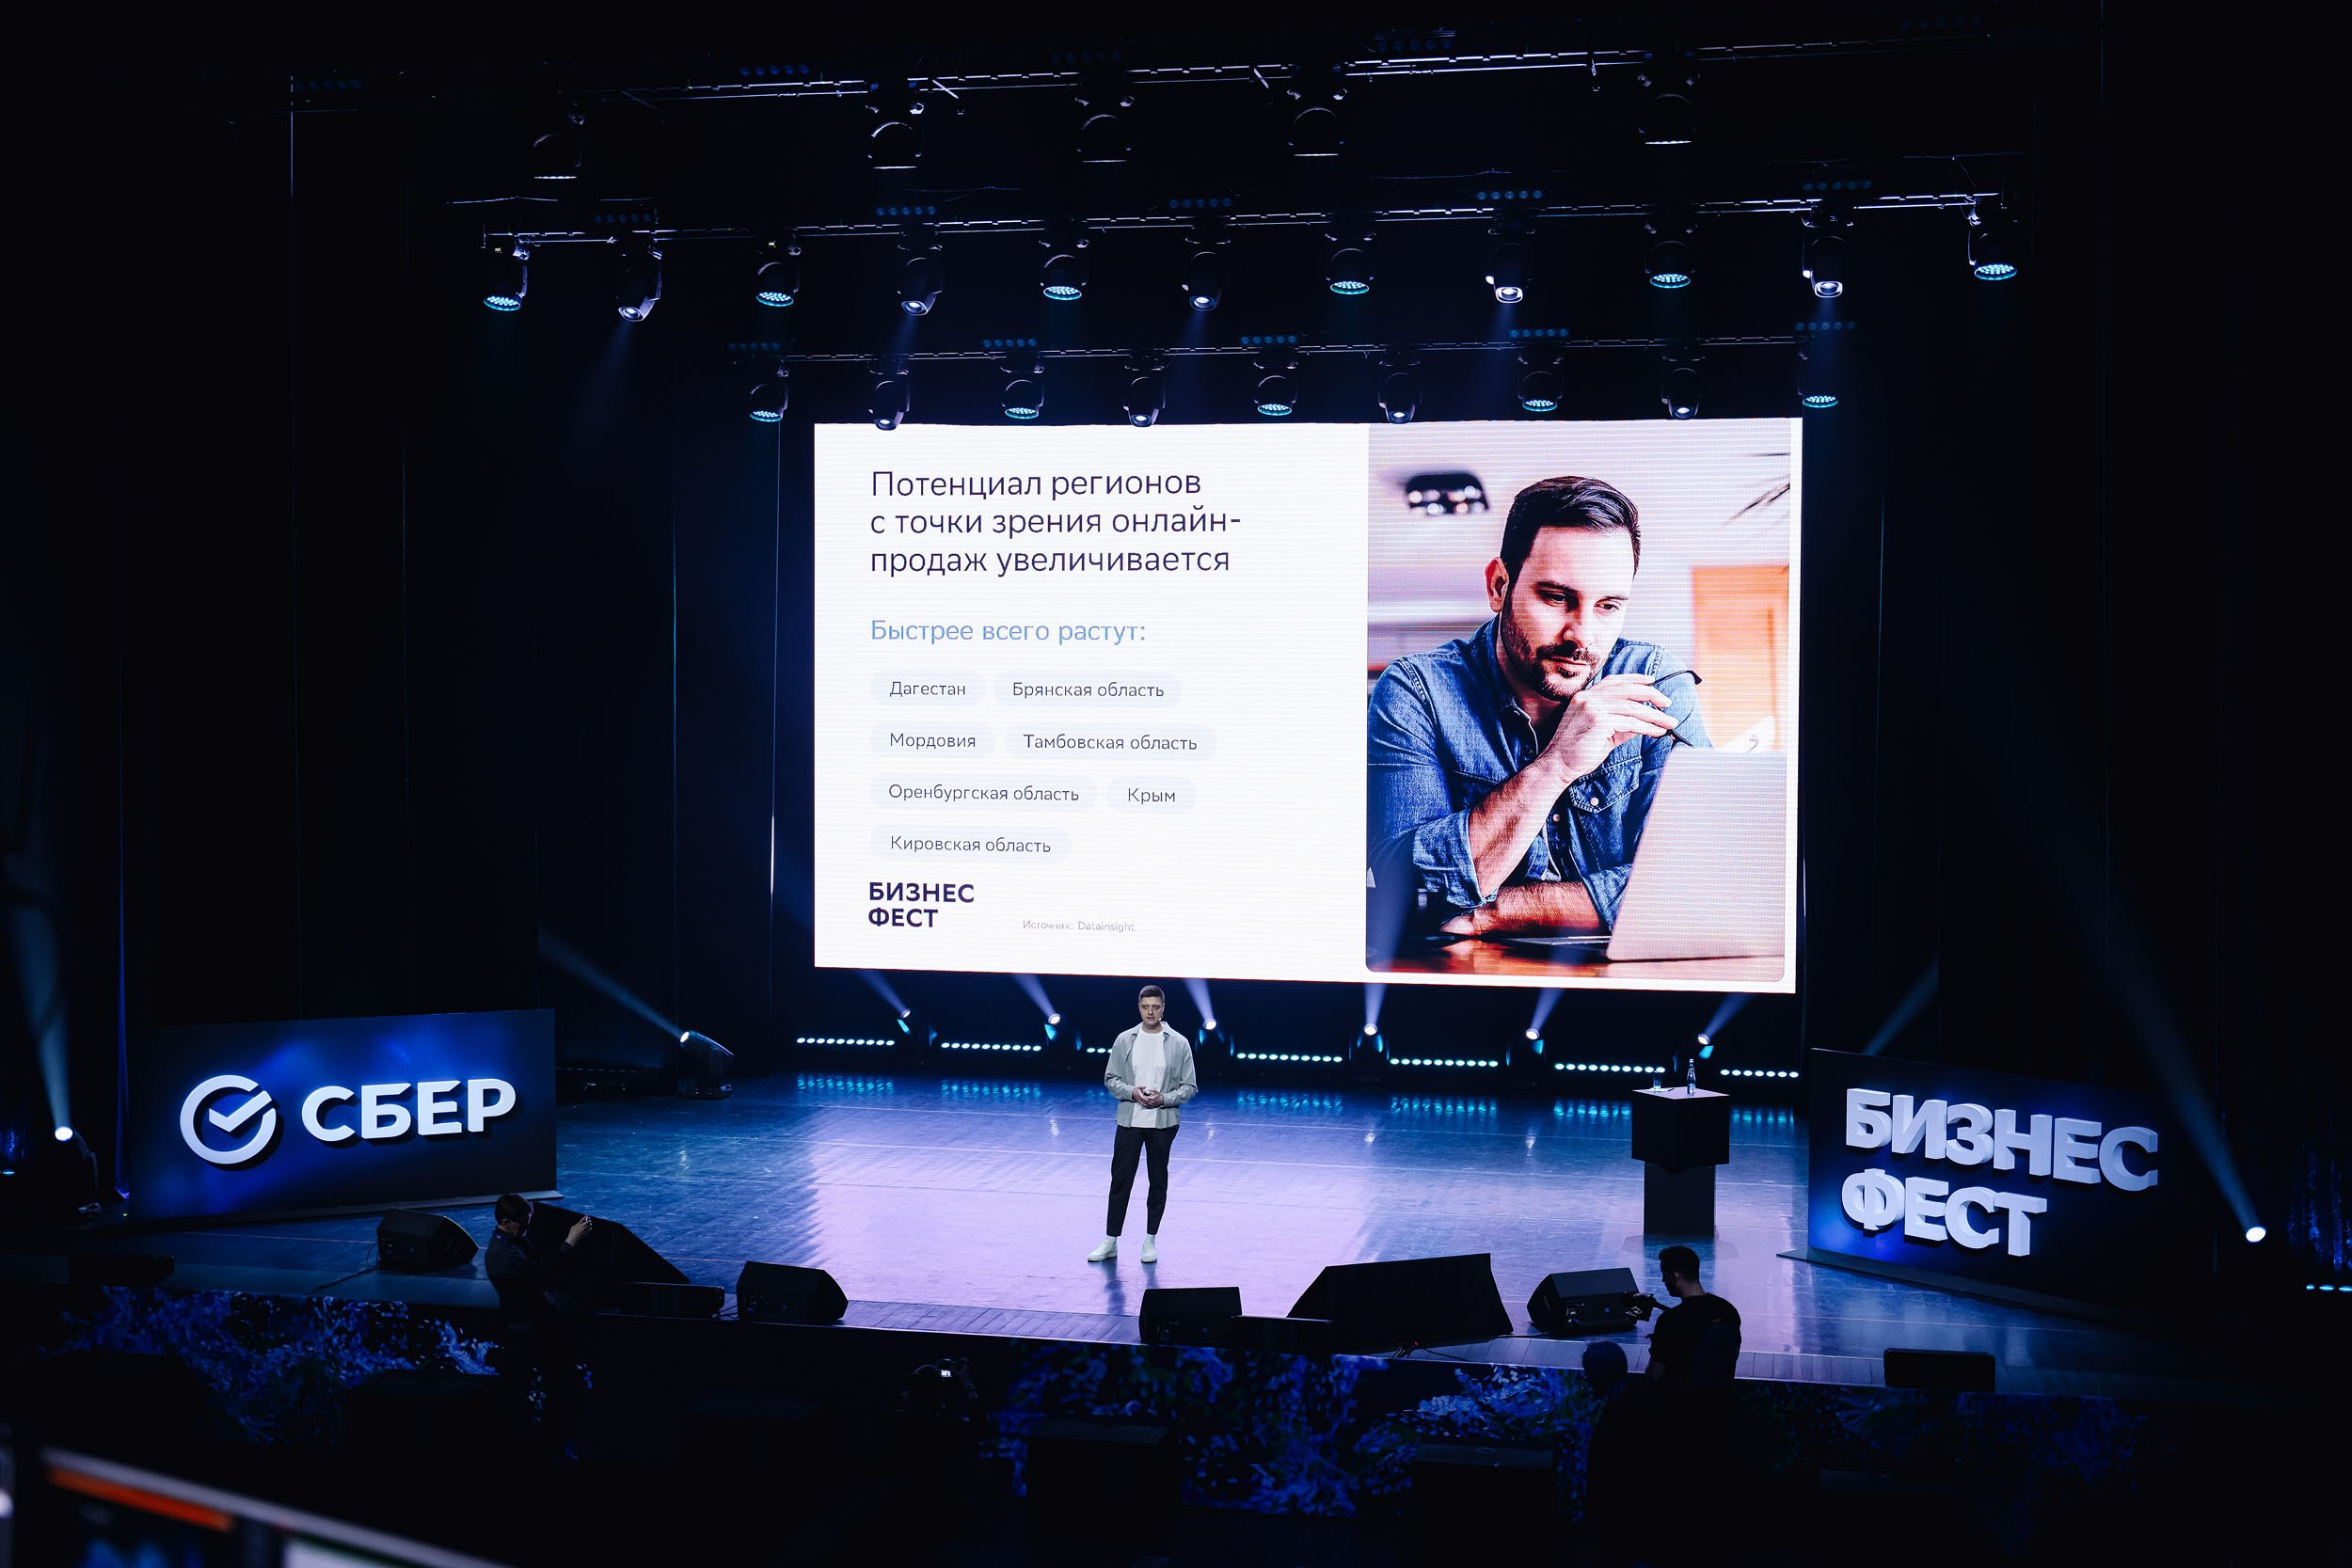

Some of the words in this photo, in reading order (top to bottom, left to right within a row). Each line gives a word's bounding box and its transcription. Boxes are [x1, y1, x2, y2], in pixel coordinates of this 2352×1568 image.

[873, 471, 1041, 499] Потенциал
[1053, 475, 1200, 500] регионов
[871, 515, 884, 533] с
[896, 515, 981, 533] точки
[993, 515, 1100, 539] зрения
[1113, 505, 1240, 532] онлайн-
[872, 553, 987, 578] продаж
[996, 552, 1229, 577] увеличивается
[872, 620, 973, 644] Быстрее
[983, 626, 1049, 640] всего
[1059, 626, 1145, 645] растут:
[890, 682, 965, 697] Дагестан
[1013, 682, 1091, 699] Брянская
[1098, 682, 1164, 696] область
[891, 733, 975, 750] Мордовия
[1024, 734, 1123, 749] Тамбовская
[1131, 735, 1197, 750] область
[889, 784, 1008, 802] Оренбургская
[1014, 785, 1078, 800] область
[1129, 788, 1175, 804] Крым
[892, 836, 979, 852] Кировская
[986, 837, 1050, 852] область
[870, 882, 974, 903] БИЗНЕС
[868, 908, 938, 927] ФЕСТ
[301, 1078, 516, 1142] СБЕР
[1846, 1088, 2158, 1192] БИЗНЕС
[1841, 1168, 2047, 1257] ФЕСТ
